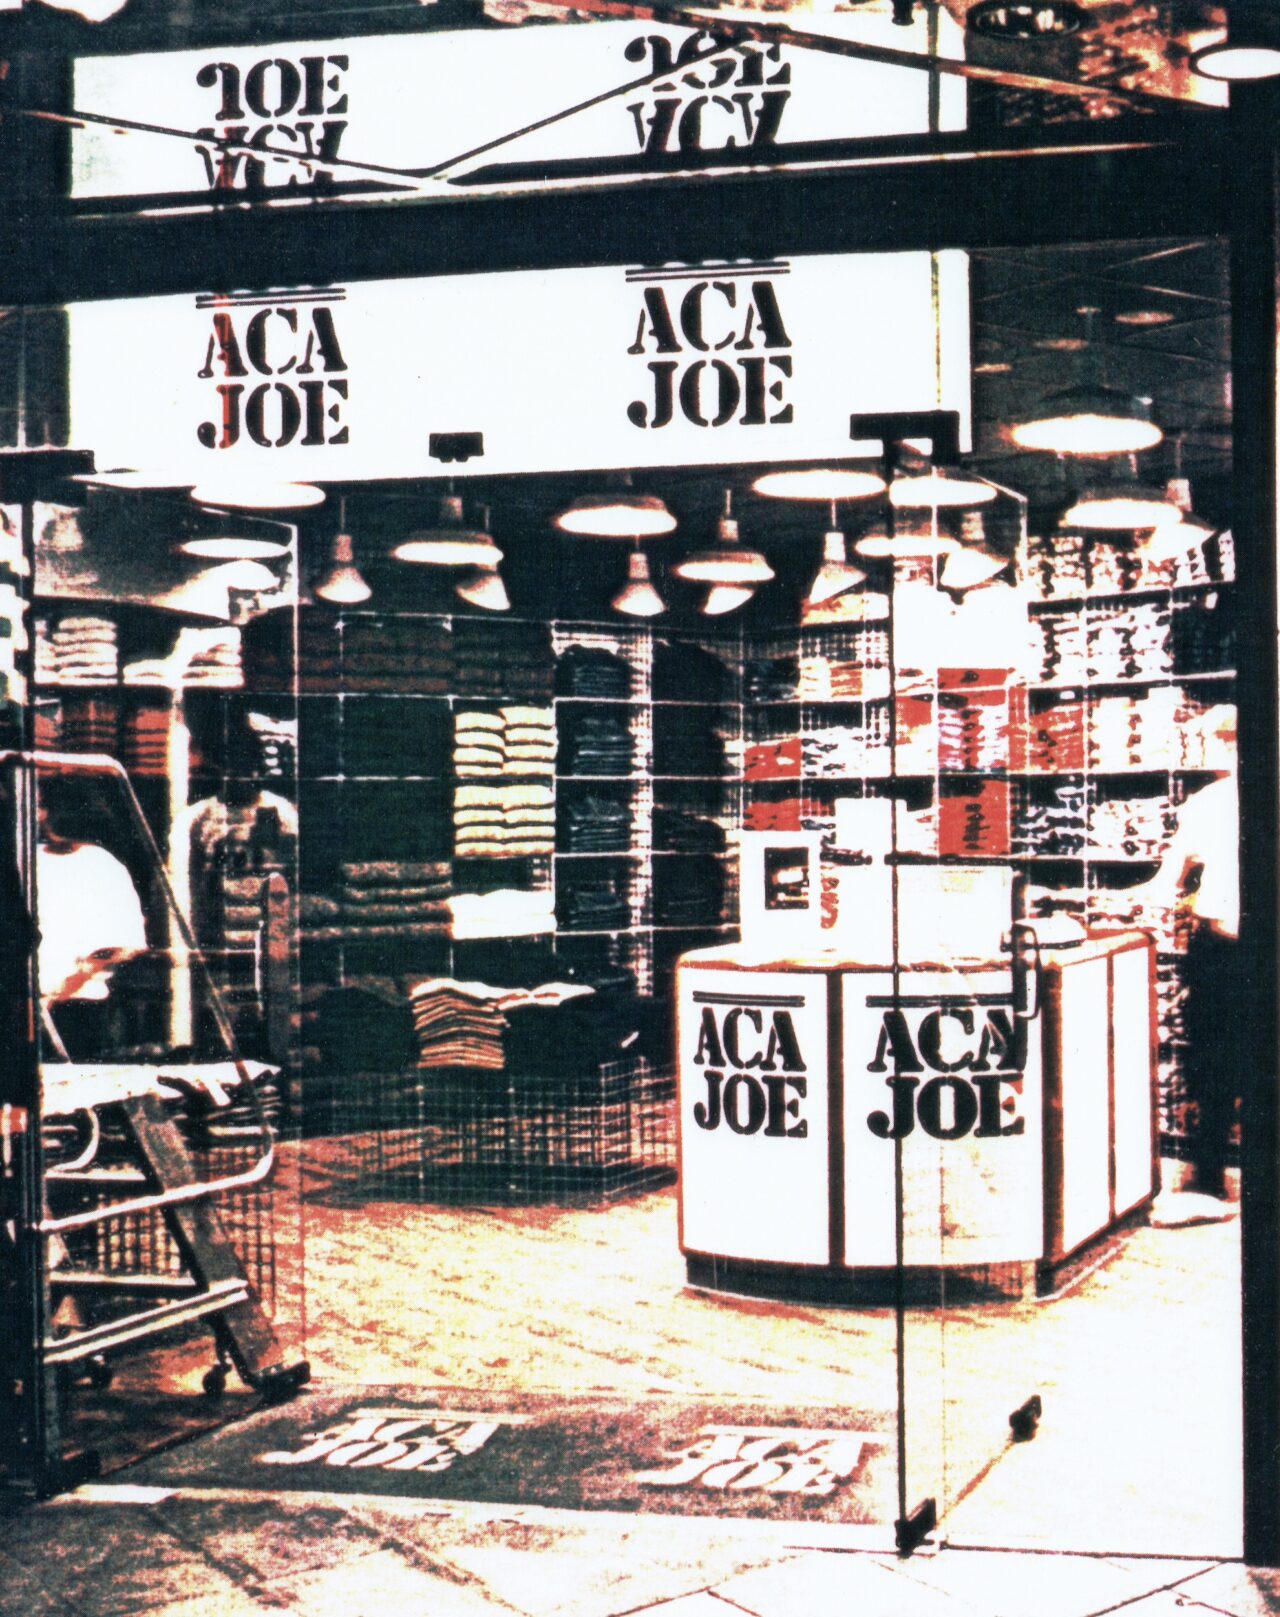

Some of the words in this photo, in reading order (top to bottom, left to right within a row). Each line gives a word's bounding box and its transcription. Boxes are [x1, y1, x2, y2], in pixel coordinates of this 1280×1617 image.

[197, 306, 348, 378] ACA
[626, 280, 792, 355] ACA
[197, 379, 349, 449] JOE
[626, 356, 793, 428] JOE
[693, 1007, 807, 1071] ACA
[866, 1008, 1027, 1072] ACA
[693, 1071, 808, 1138] JOE
[866, 1073, 1025, 1140] JOE
[252, 1440, 456, 1472] JOE
[302, 1417, 500, 1455] ACA
[628, 1459, 837, 1494] JOE
